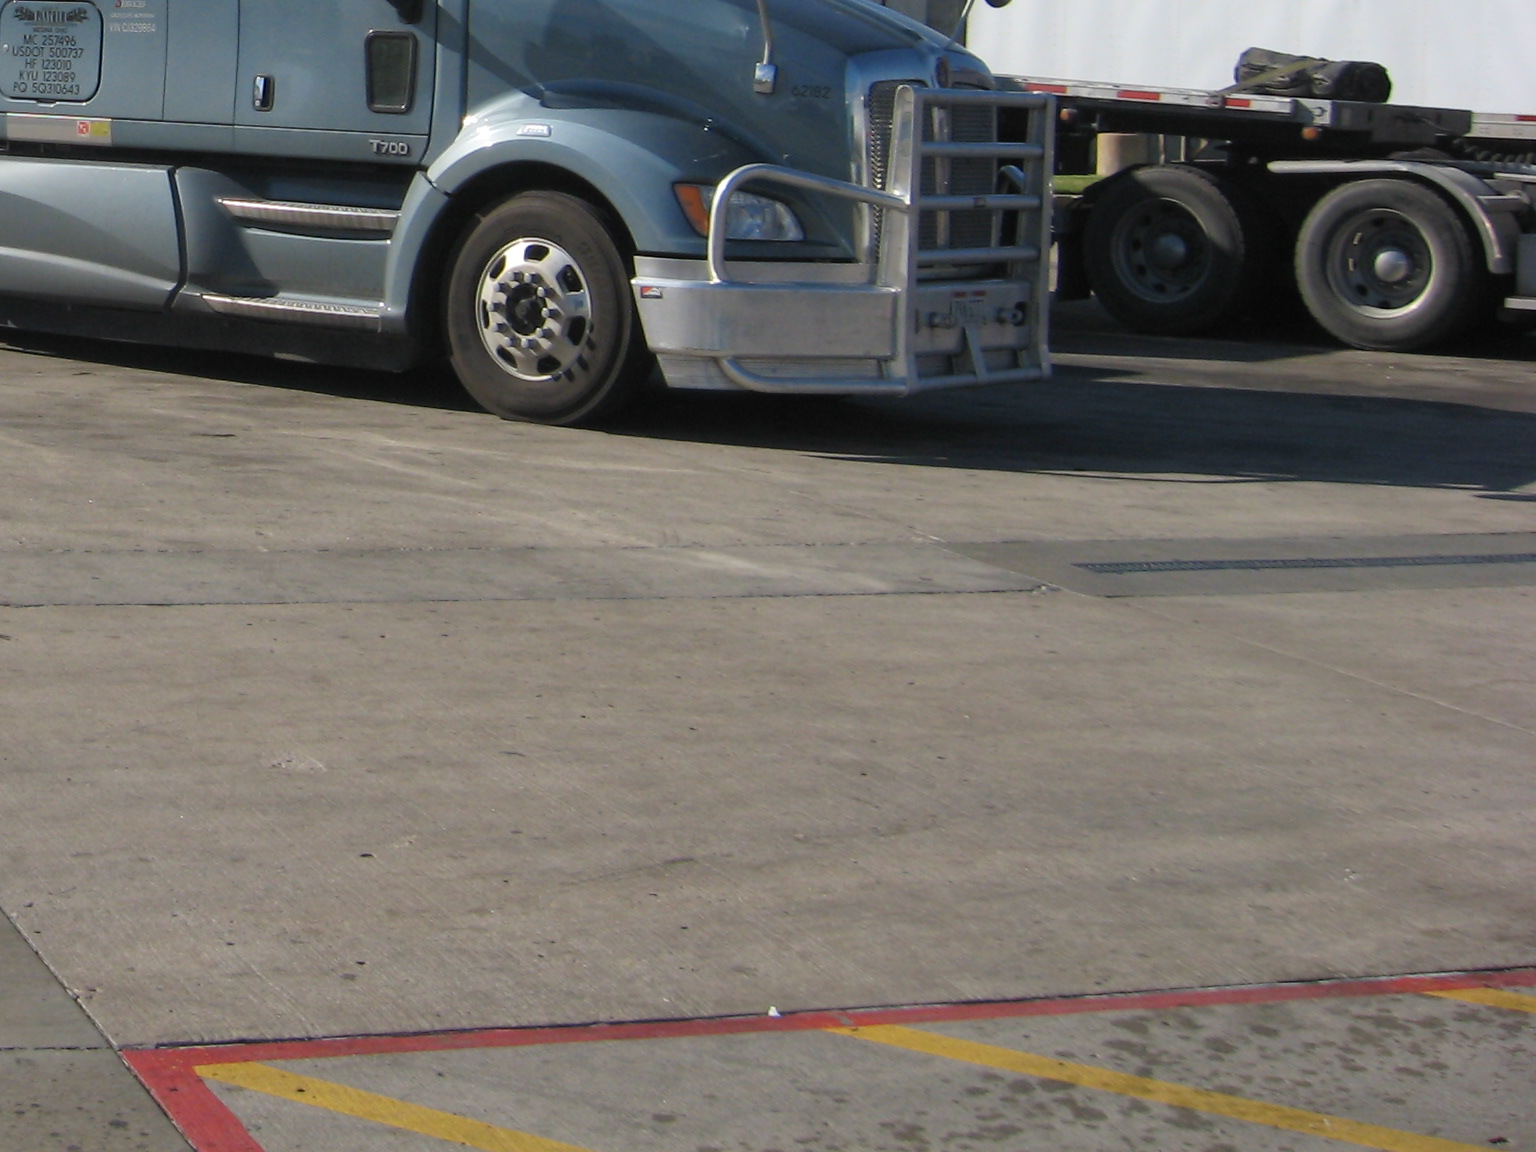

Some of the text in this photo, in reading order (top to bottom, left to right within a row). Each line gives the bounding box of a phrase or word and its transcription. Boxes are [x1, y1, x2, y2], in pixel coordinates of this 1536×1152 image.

[23, 34, 77, 47] MC 257496
[12, 46, 84, 59] USDOT 500737
[25, 58, 38, 69] HF
[19, 70, 39, 81] KYU
[369, 139, 409, 155] T700
